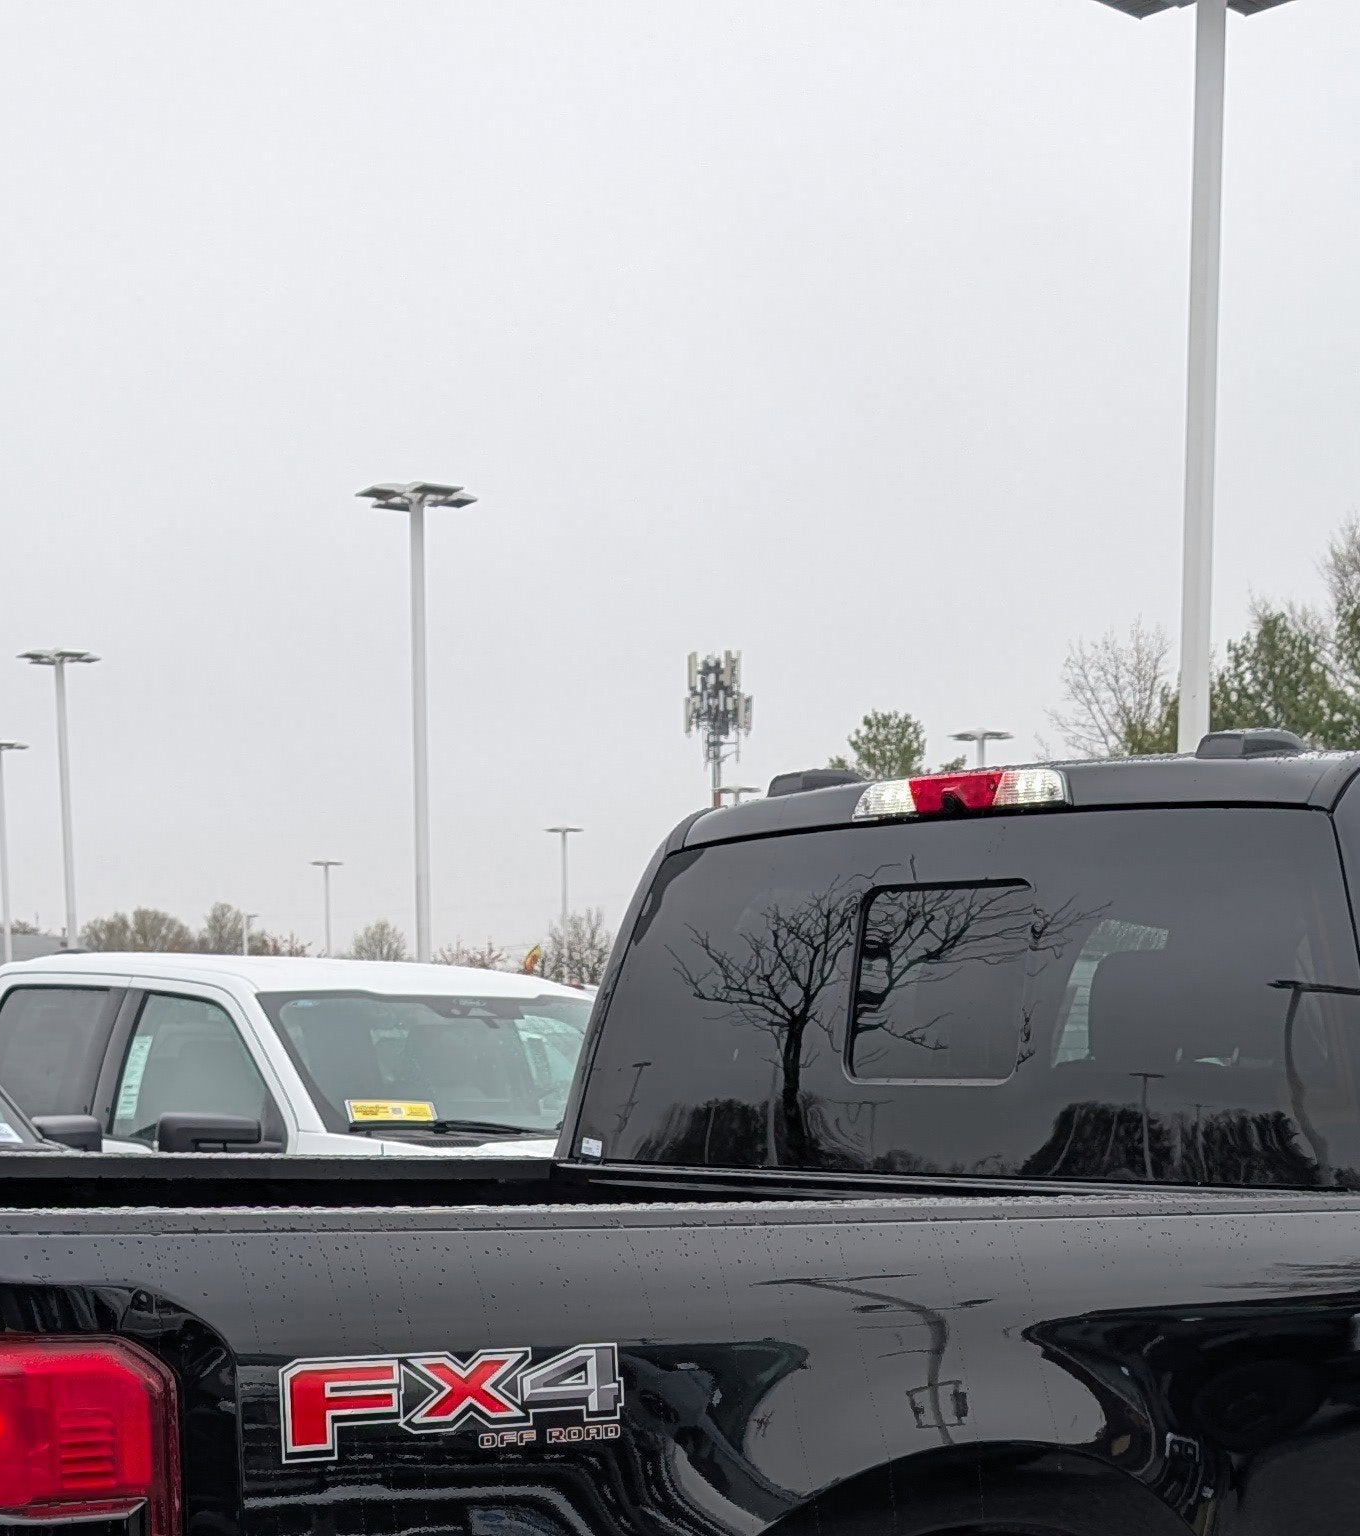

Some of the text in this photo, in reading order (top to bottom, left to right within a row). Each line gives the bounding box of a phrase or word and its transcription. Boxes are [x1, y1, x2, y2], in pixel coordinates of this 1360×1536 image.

[279, 1342, 624, 1464] FX4
[478, 1423, 621, 1449] OFF ROAD
